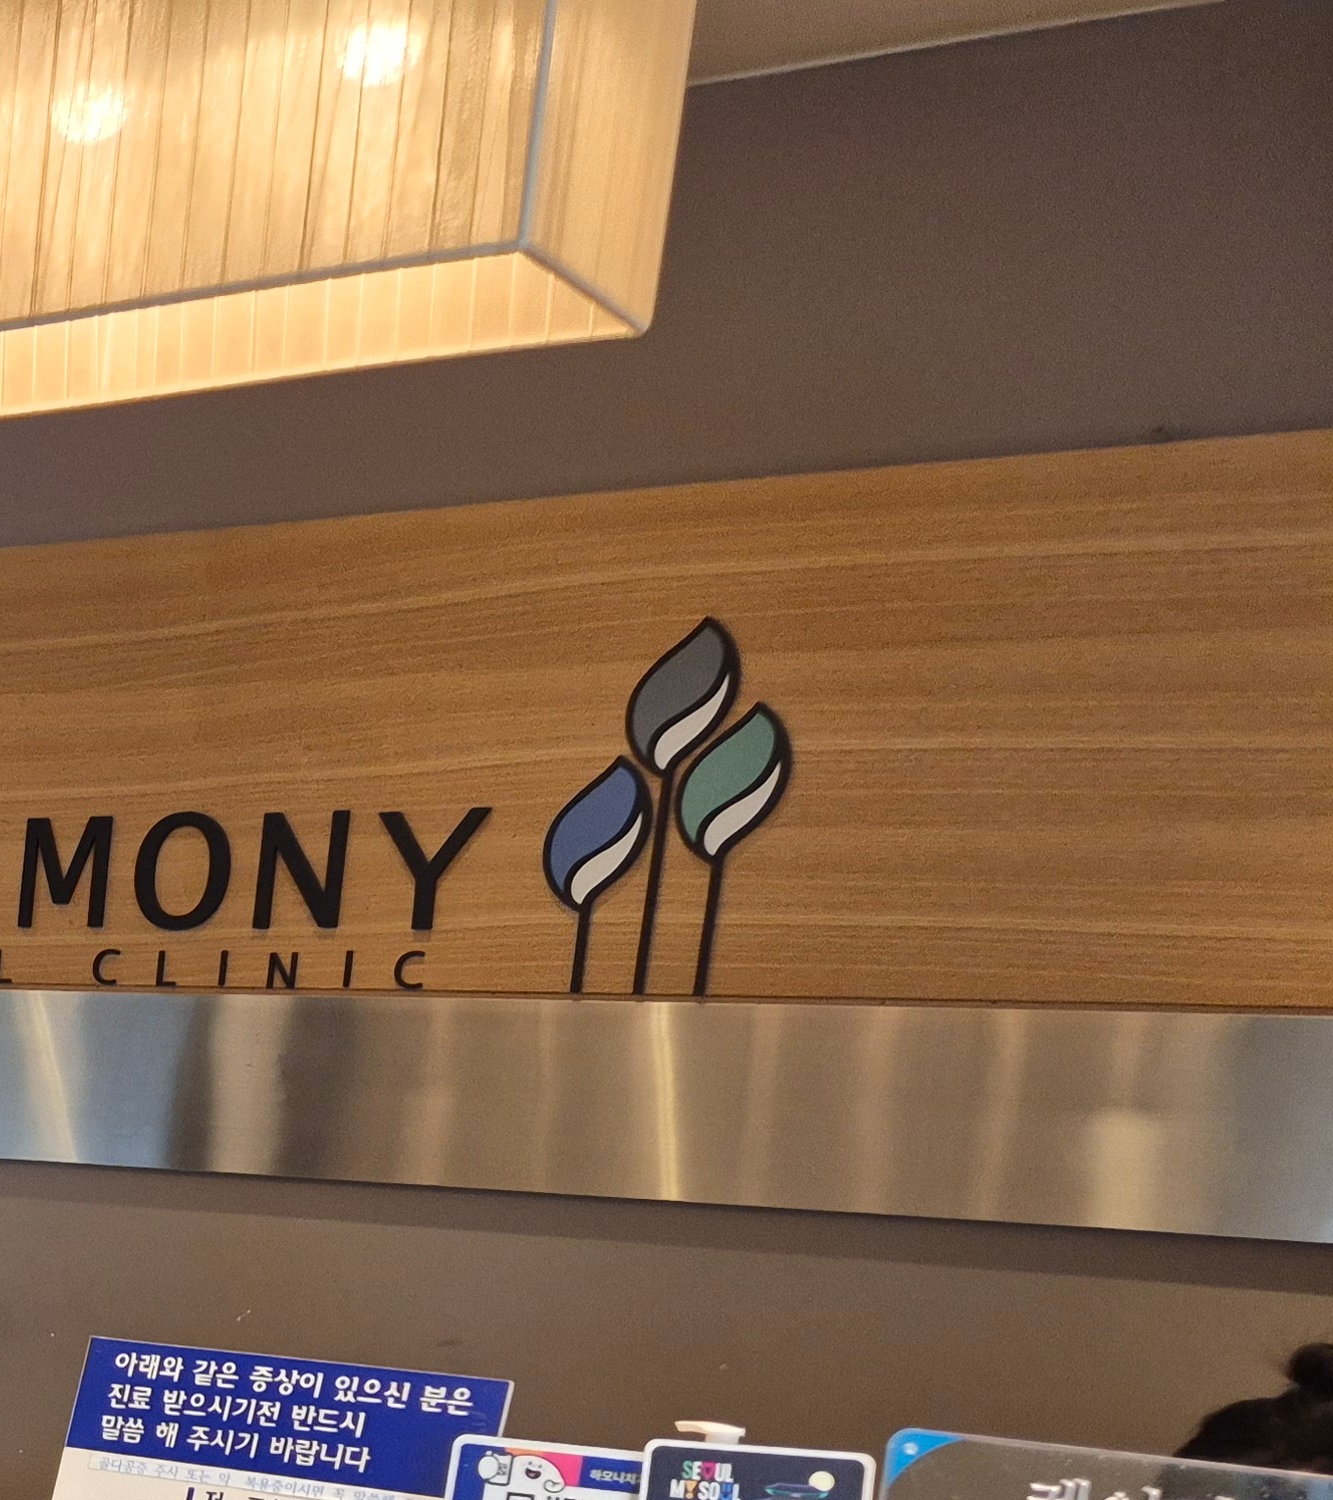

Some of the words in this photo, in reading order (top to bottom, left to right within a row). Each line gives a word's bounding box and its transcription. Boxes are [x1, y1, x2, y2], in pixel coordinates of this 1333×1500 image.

[92, 948, 426, 993] CLINIC
[114, 1351, 185, 1383] 아래와
[193, 1358, 240, 1389] 같은
[248, 1364, 325, 1398] 증상이
[333, 1375, 412, 1410] 있으신
[418, 1384, 474, 1417] 분은
[107, 1383, 153, 1413] 진료
[162, 1388, 281, 1428] 받으시기전
[291, 1404, 367, 1438] 반드시
[100, 1414, 145, 1444] 말씀
[155, 1421, 178, 1449] 해
[186, 1425, 260, 1458] 주시기
[269, 1436, 371, 1473] 바랍니다
[98, 1456, 149, 1476] 골다공증
[185, 1466, 211, 1484] 또는
[244, 1474, 325, 1497] 복용중이시면
[682, 1460, 733, 1482] SEOUL
